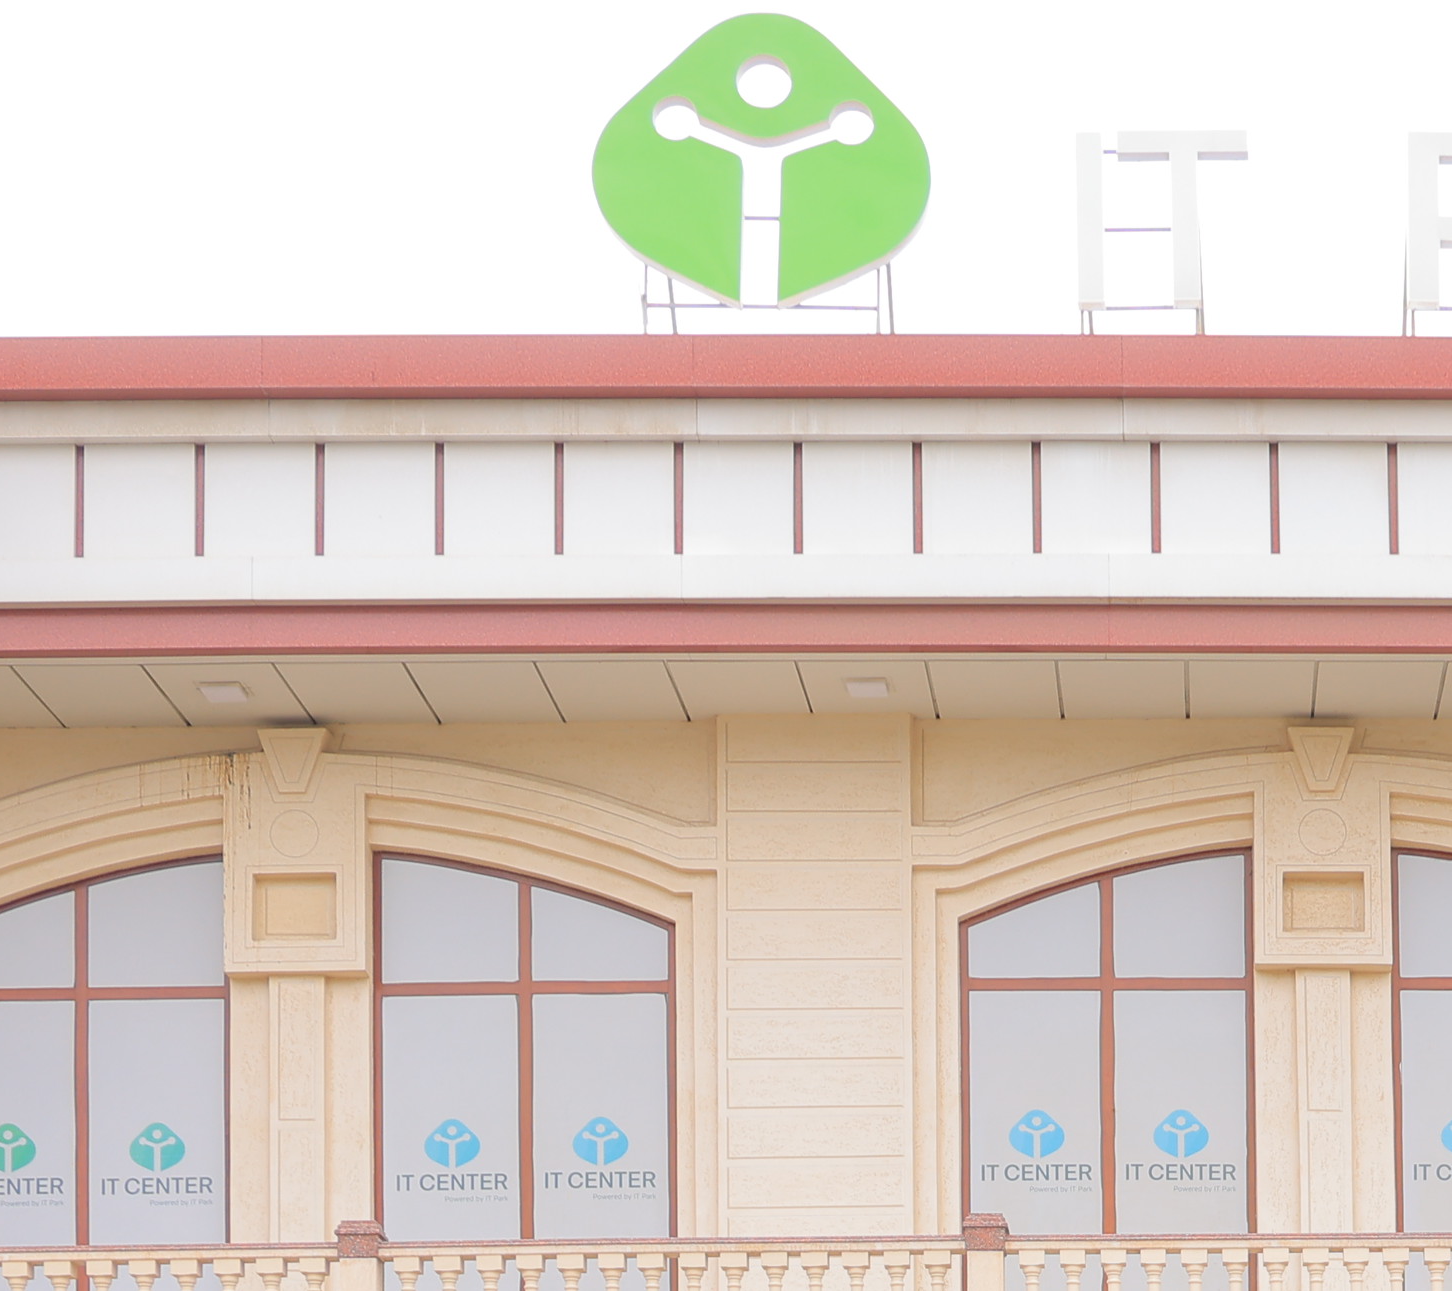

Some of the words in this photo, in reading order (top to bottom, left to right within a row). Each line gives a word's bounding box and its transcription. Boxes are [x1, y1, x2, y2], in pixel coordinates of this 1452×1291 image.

[1075, 130, 1248, 311] IT
[545, 1172, 563, 1189] IT
[568, 1171, 656, 1188] CENTER
[981, 1164, 999, 1181] IT
[1004, 1164, 1092, 1181] CENTER
[1125, 1164, 1144, 1181] IT
[1148, 1164, 1236, 1181] CENTER
[1413, 1164, 1431, 1181] IT
[101, 1179, 119, 1195] IT
[124, 1177, 213, 1195] CENTER
[396, 1175, 415, 1191] IT
[419, 1173, 508, 1191] CENTER
